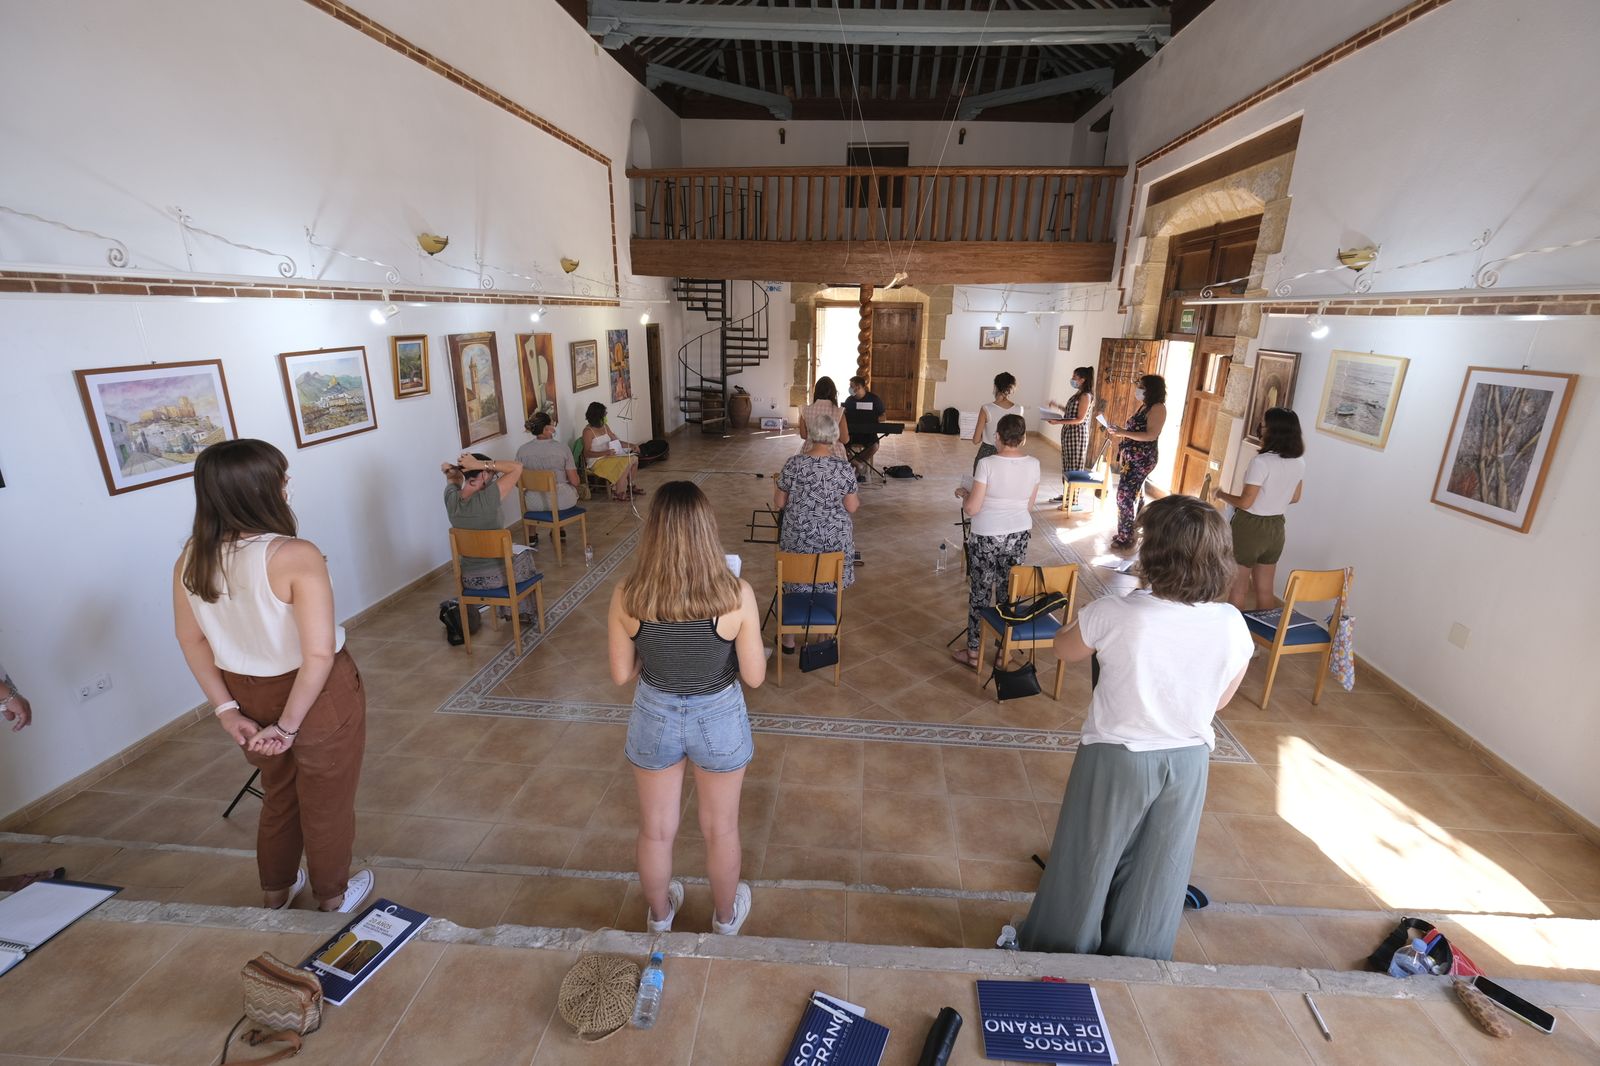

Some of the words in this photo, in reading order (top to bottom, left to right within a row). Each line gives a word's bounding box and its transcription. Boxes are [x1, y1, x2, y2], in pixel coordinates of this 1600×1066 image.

[984, 1019, 1070, 1036] VERANO
[1073, 1023, 1103, 1038] DE
[1022, 1036, 1106, 1054] CURSOS
